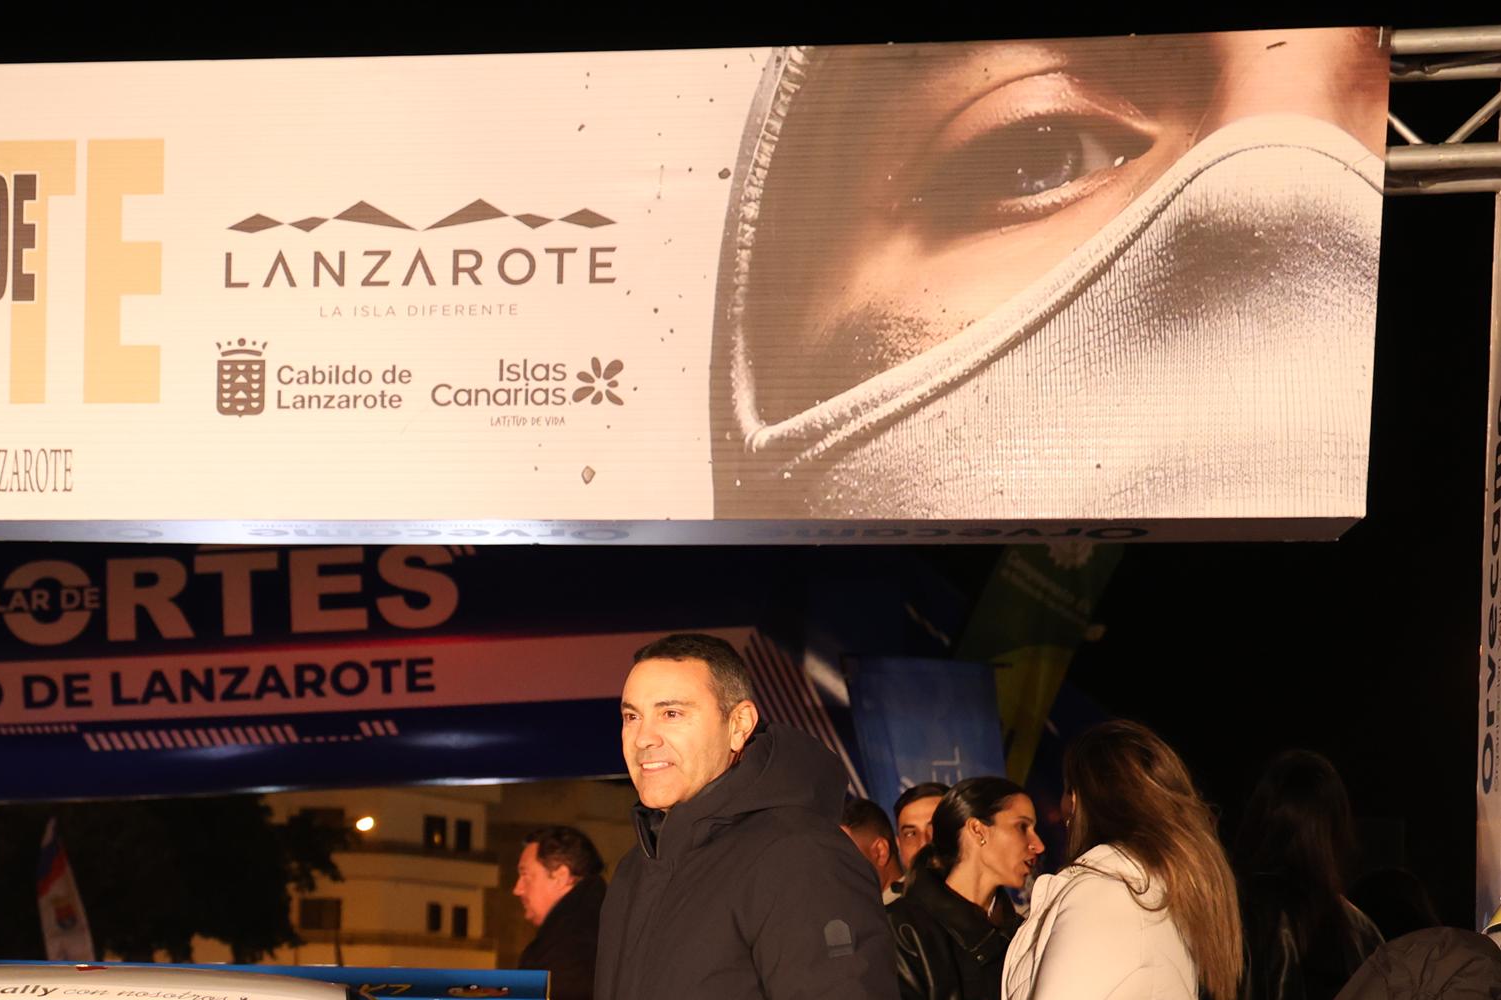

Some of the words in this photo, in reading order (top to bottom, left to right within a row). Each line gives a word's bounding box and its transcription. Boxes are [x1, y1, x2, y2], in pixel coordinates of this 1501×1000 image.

[224, 246, 618, 289] LANZAROTE
[319, 304, 343, 318] LA
[353, 304, 397, 318] ISLA
[406, 303, 520, 318] DIFERENTE
[276, 364, 373, 386] Cabildo
[381, 363, 413, 385] de
[498, 358, 568, 383] Islas
[276, 389, 404, 409] Lanzarote
[430, 382, 567, 407] Canarias
[59, 586, 101, 611] DE
[21, 672, 94, 710] DE
[109, 657, 437, 707] LANZAROTE
